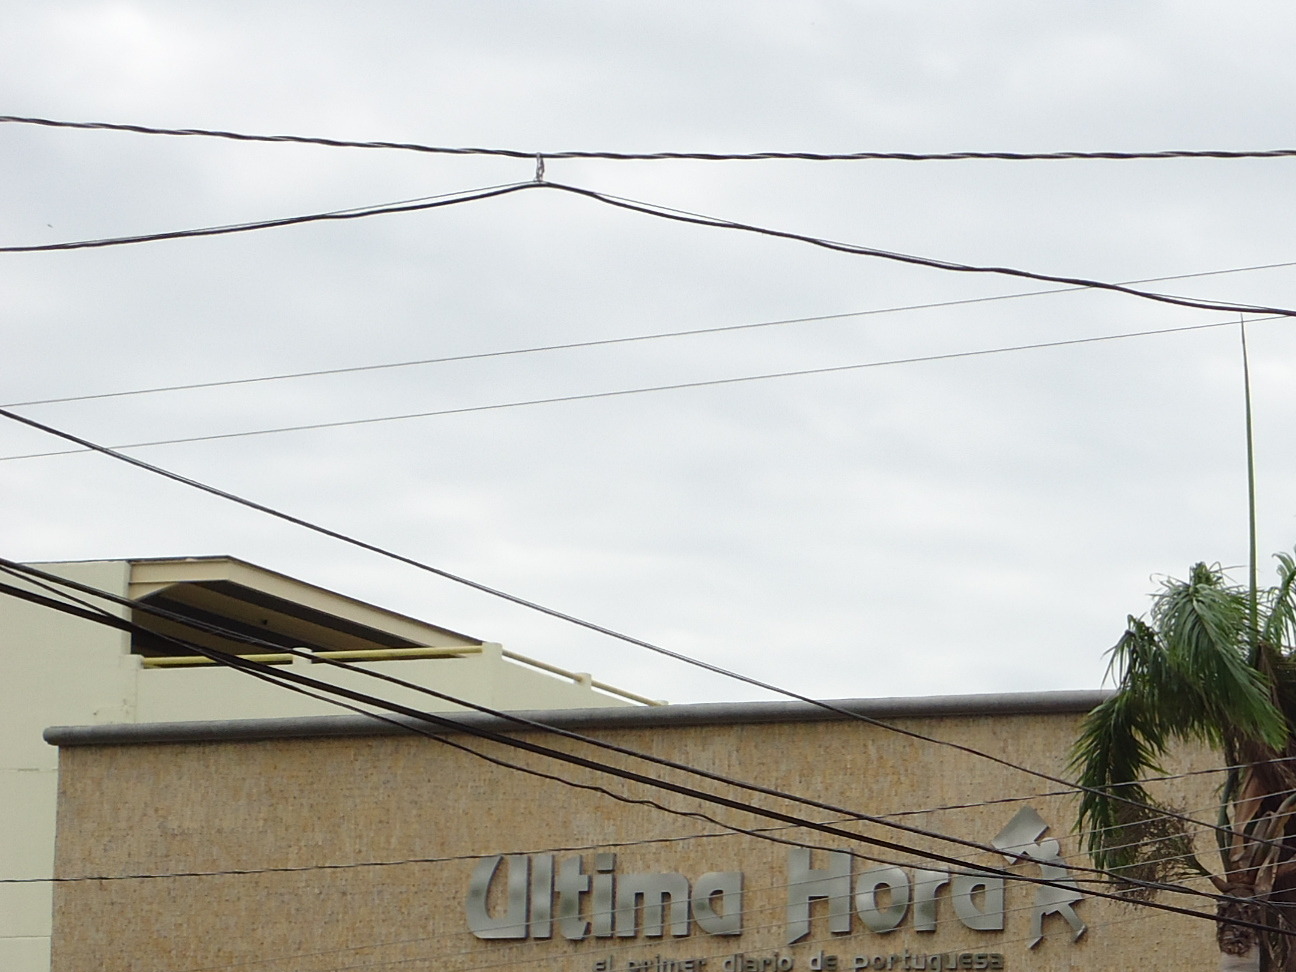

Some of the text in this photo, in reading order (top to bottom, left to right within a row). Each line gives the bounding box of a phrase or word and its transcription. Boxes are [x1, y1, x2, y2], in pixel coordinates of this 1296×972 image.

[466, 847, 1005, 945] Ultima Hora
[809, 949, 838, 972] de
